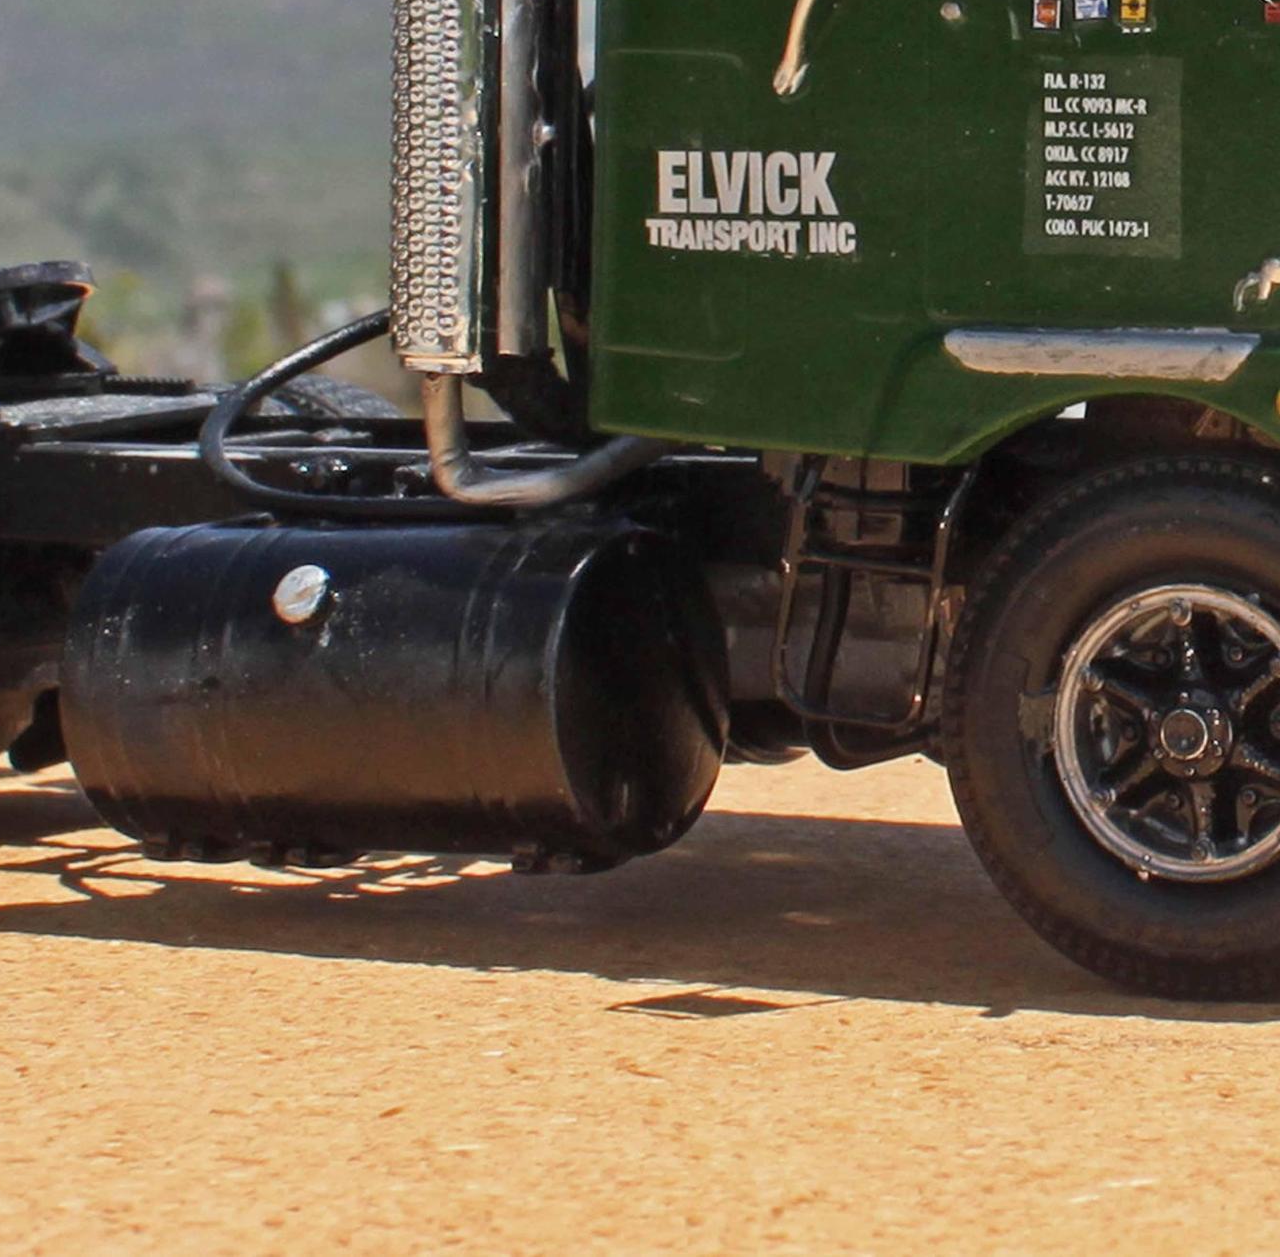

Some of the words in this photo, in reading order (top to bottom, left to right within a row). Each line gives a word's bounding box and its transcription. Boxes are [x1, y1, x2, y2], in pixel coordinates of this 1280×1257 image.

[1069, 73, 1106, 90] R-132
[1064, 96, 1081, 114] CC
[1082, 97, 1113, 115] 9093
[1080, 145, 1097, 163] CC
[1097, 146, 1129, 164] 8917
[657, 150, 840, 217] ELVICK
[1044, 169, 1067, 187] ACC
[1092, 170, 1131, 188] 12108
[645, 218, 801, 254] TRANSPORT
[808, 220, 857, 255] INC
[1044, 218, 1080, 236] COLO.
[1081, 219, 1106, 237] PUC
